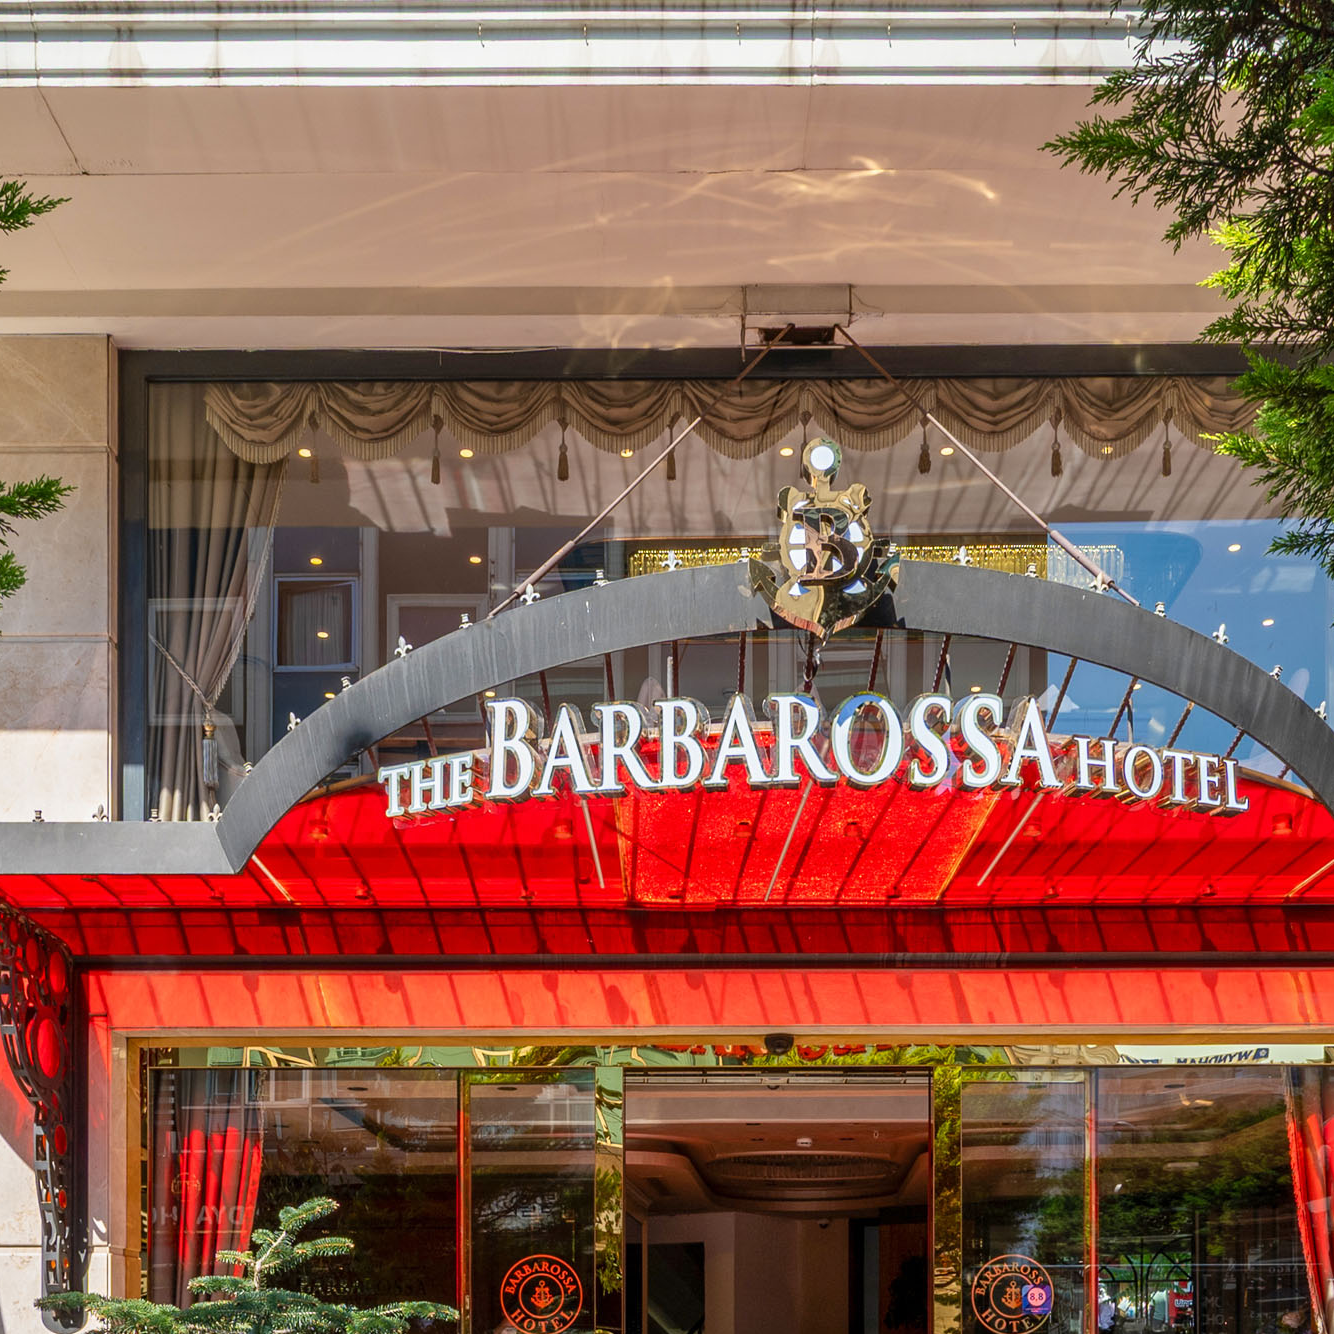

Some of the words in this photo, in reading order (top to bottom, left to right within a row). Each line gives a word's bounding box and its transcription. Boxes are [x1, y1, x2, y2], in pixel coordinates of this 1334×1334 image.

[378, 755, 475, 820] THE
[485, 692, 1065, 798] BARBAROSSA
[1072, 735, 1251, 814] HOTEL
[505, 1261, 577, 1295] BARBAROSSA
[975, 1261, 1044, 1297] BARBAROSS
[510, 1308, 574, 1333] HOTEL
